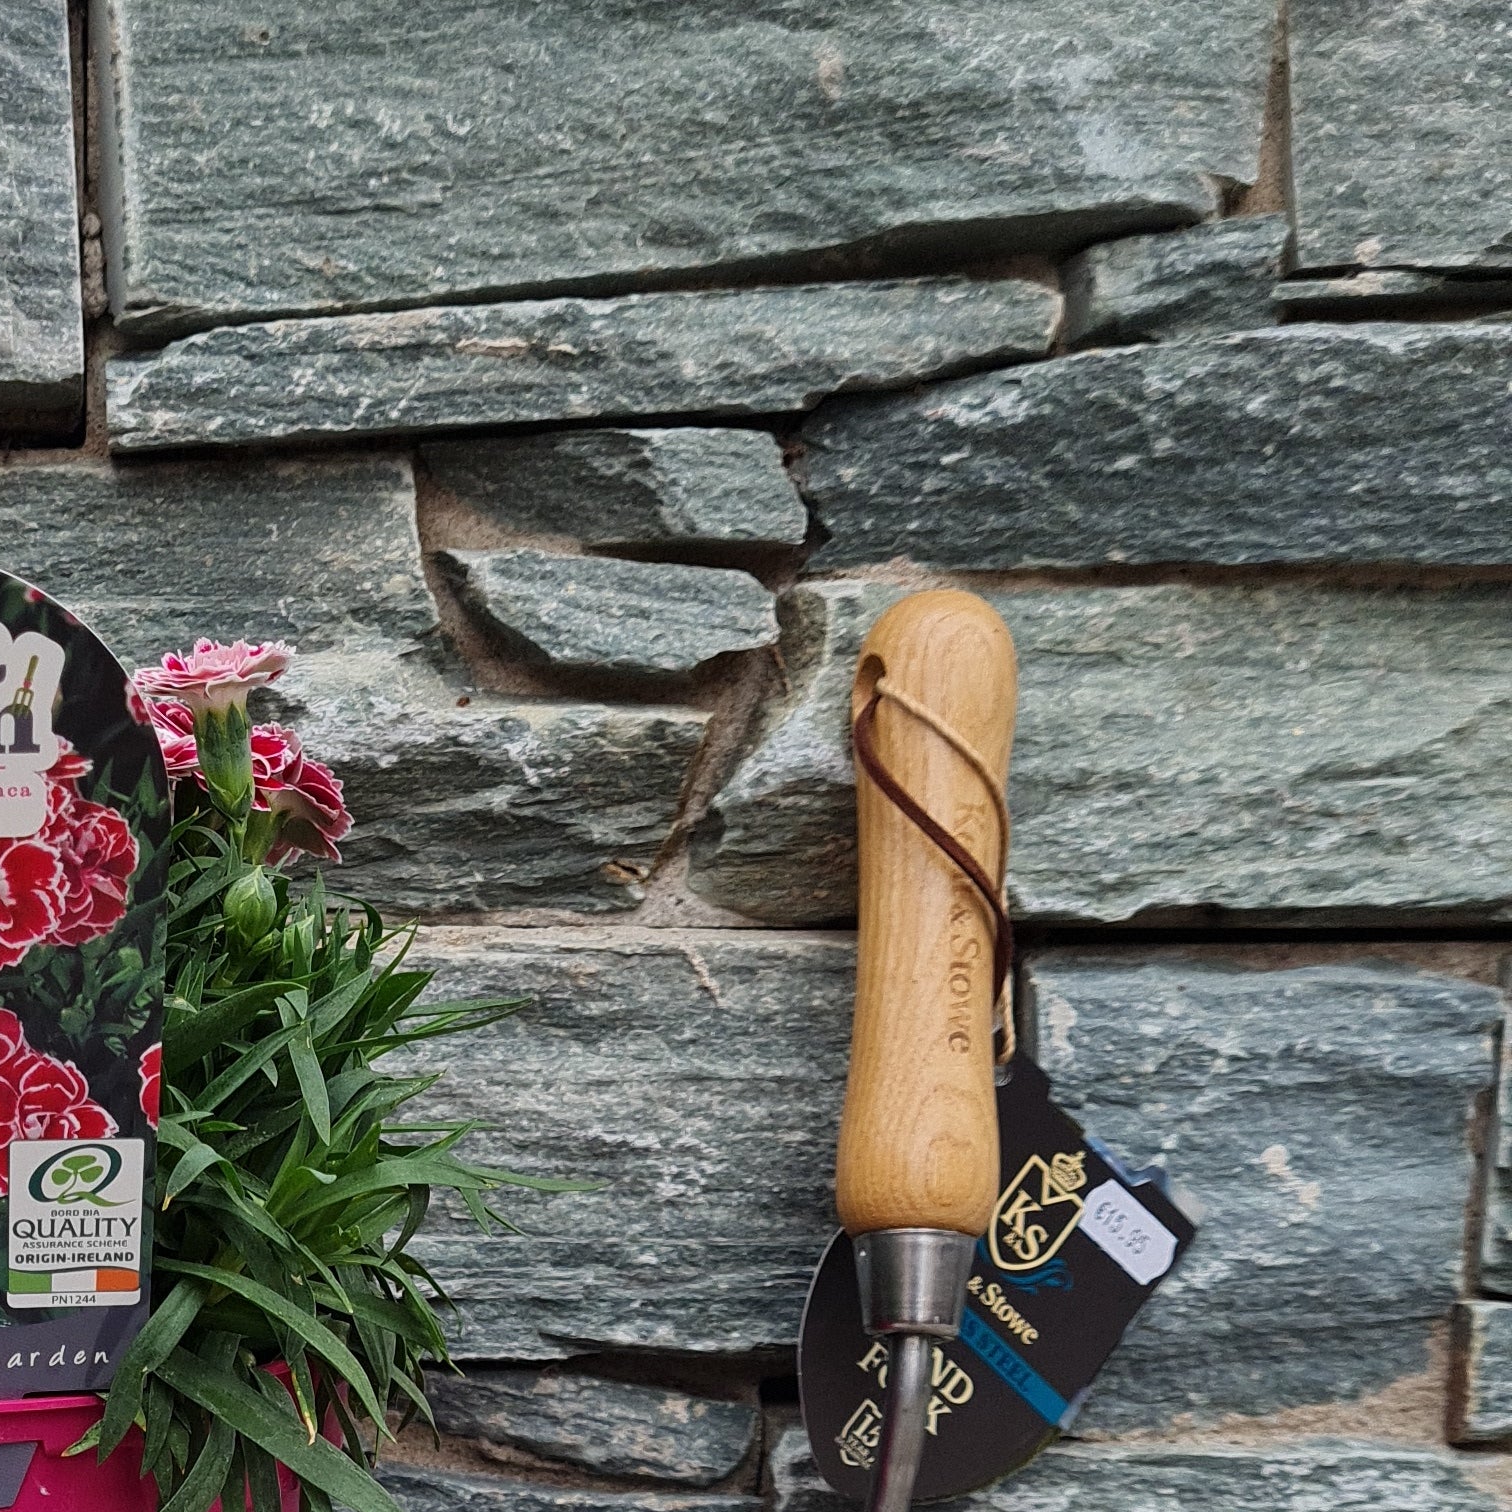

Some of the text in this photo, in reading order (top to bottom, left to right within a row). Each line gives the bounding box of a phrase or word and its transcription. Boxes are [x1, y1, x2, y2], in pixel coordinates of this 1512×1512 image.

[949, 934, 981, 1054] Stowe
[12, 1217, 138, 1240] QUALITY
[22, 1240, 128, 1249] ASSURANCE SCHEME
[51, 1295, 96, 1305] PN1244
[979, 1282, 1039, 1345] Stowe
